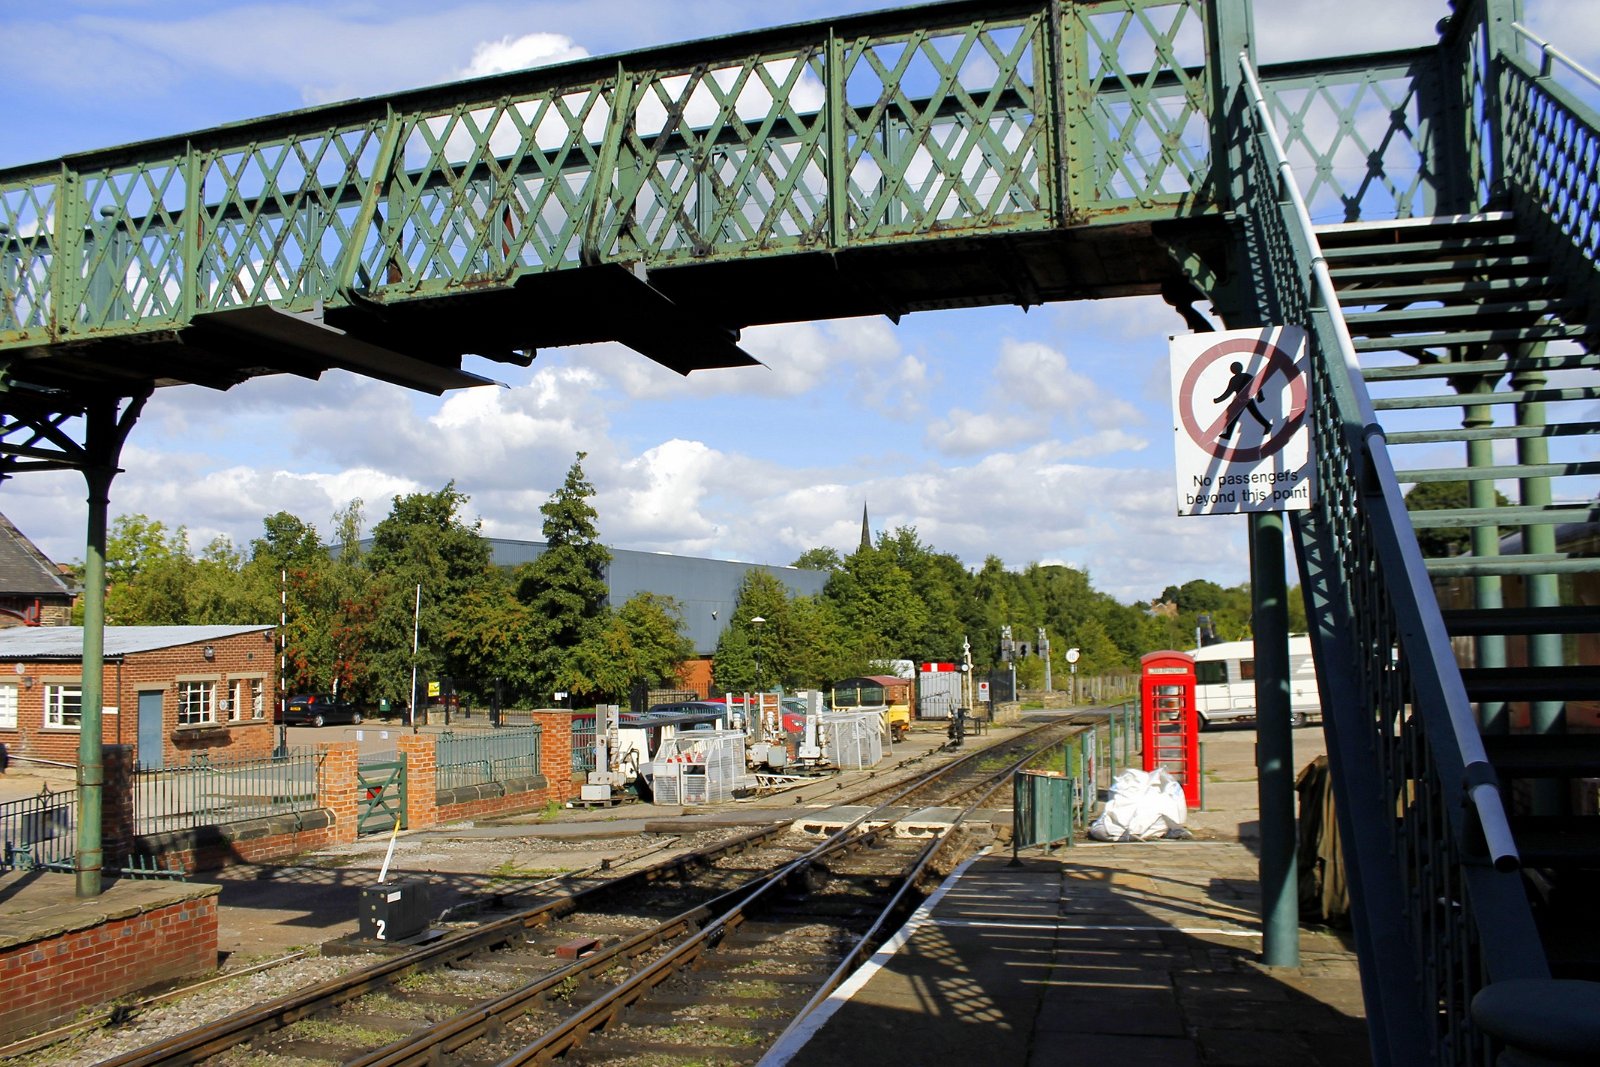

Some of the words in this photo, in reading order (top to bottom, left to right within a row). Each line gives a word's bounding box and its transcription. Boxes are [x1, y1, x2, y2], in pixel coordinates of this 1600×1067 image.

[1193, 475, 1212, 487] No
[1219, 472, 1298, 488] passengers
[1186, 490, 1236, 506] beyond
[1242, 489, 1267, 501] this
[1273, 486, 1307, 503] point
[377, 919, 385, 940] 2
